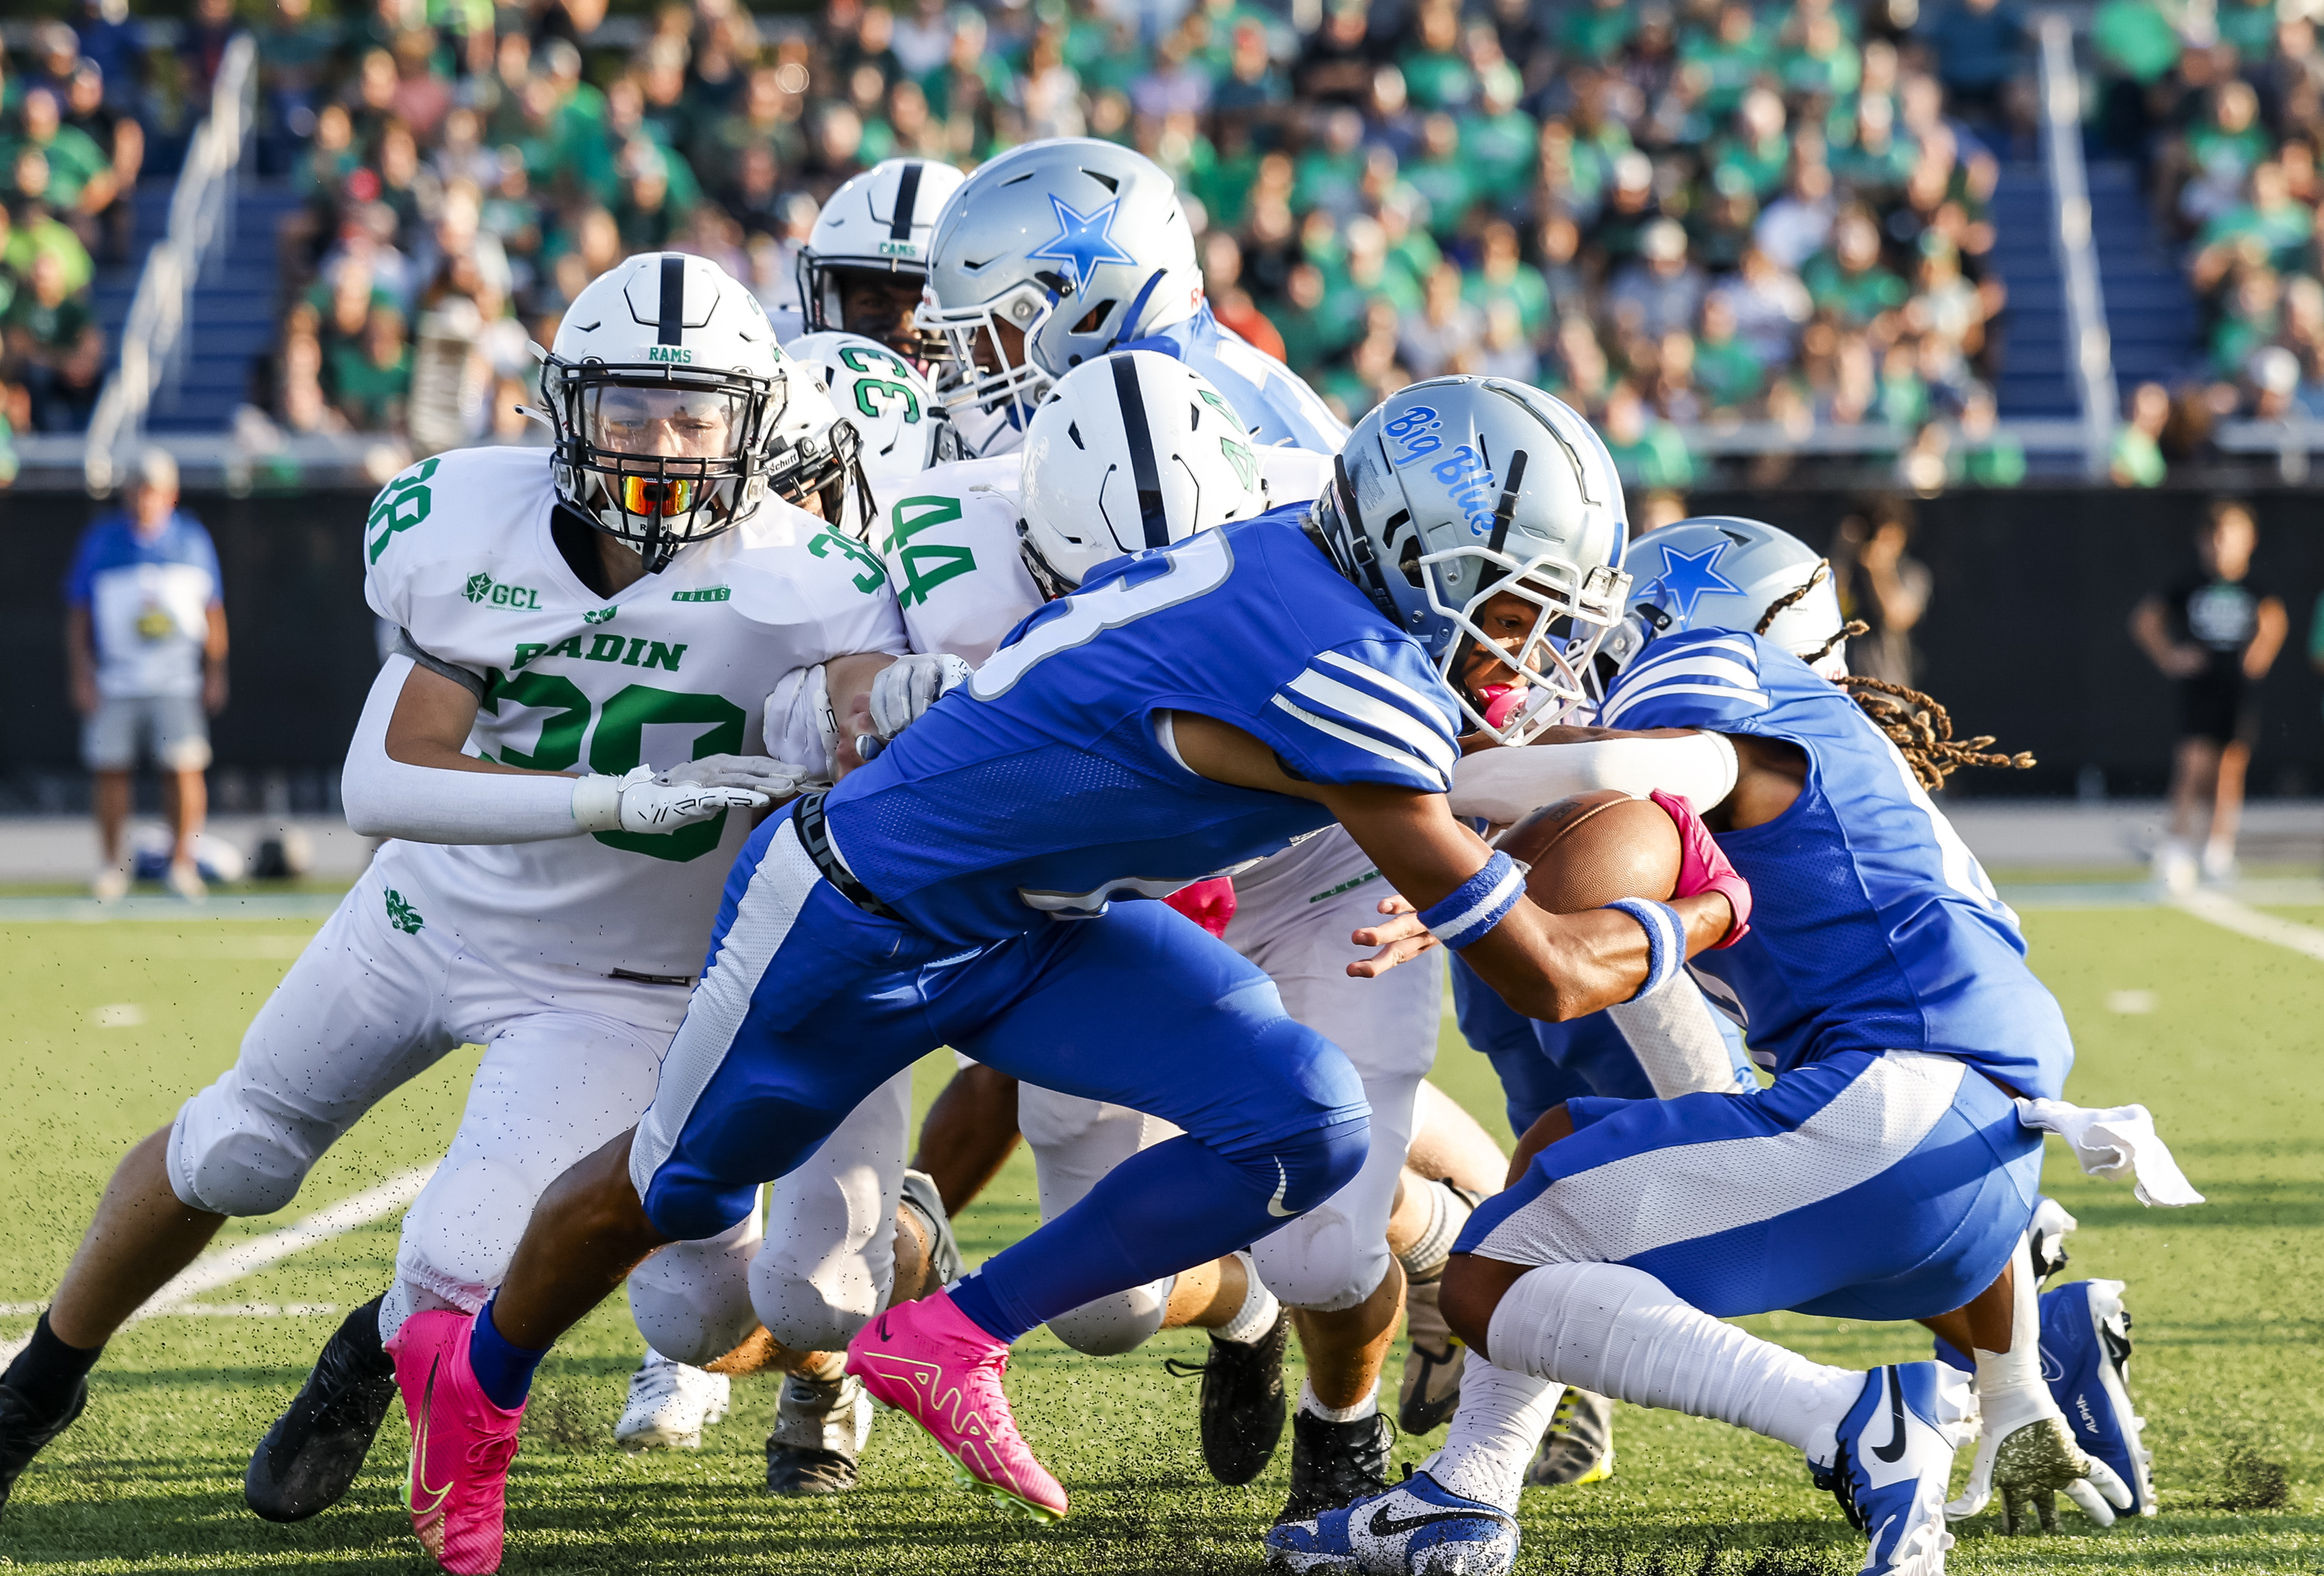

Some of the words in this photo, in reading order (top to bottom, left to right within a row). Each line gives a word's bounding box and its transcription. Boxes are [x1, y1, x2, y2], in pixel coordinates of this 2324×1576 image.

[648, 346, 692, 363] RAMS
[839, 347, 921, 424] 33
[1384, 405, 1443, 465] Big
[1430, 444, 1497, 537] Blue
[640, 524, 672, 532] Rell
[883, 495, 977, 610] 44
[491, 582, 543, 610] GCL
[676, 588, 727, 602] HOLNS
[2075, 1394, 2099, 1434] ALPHA
